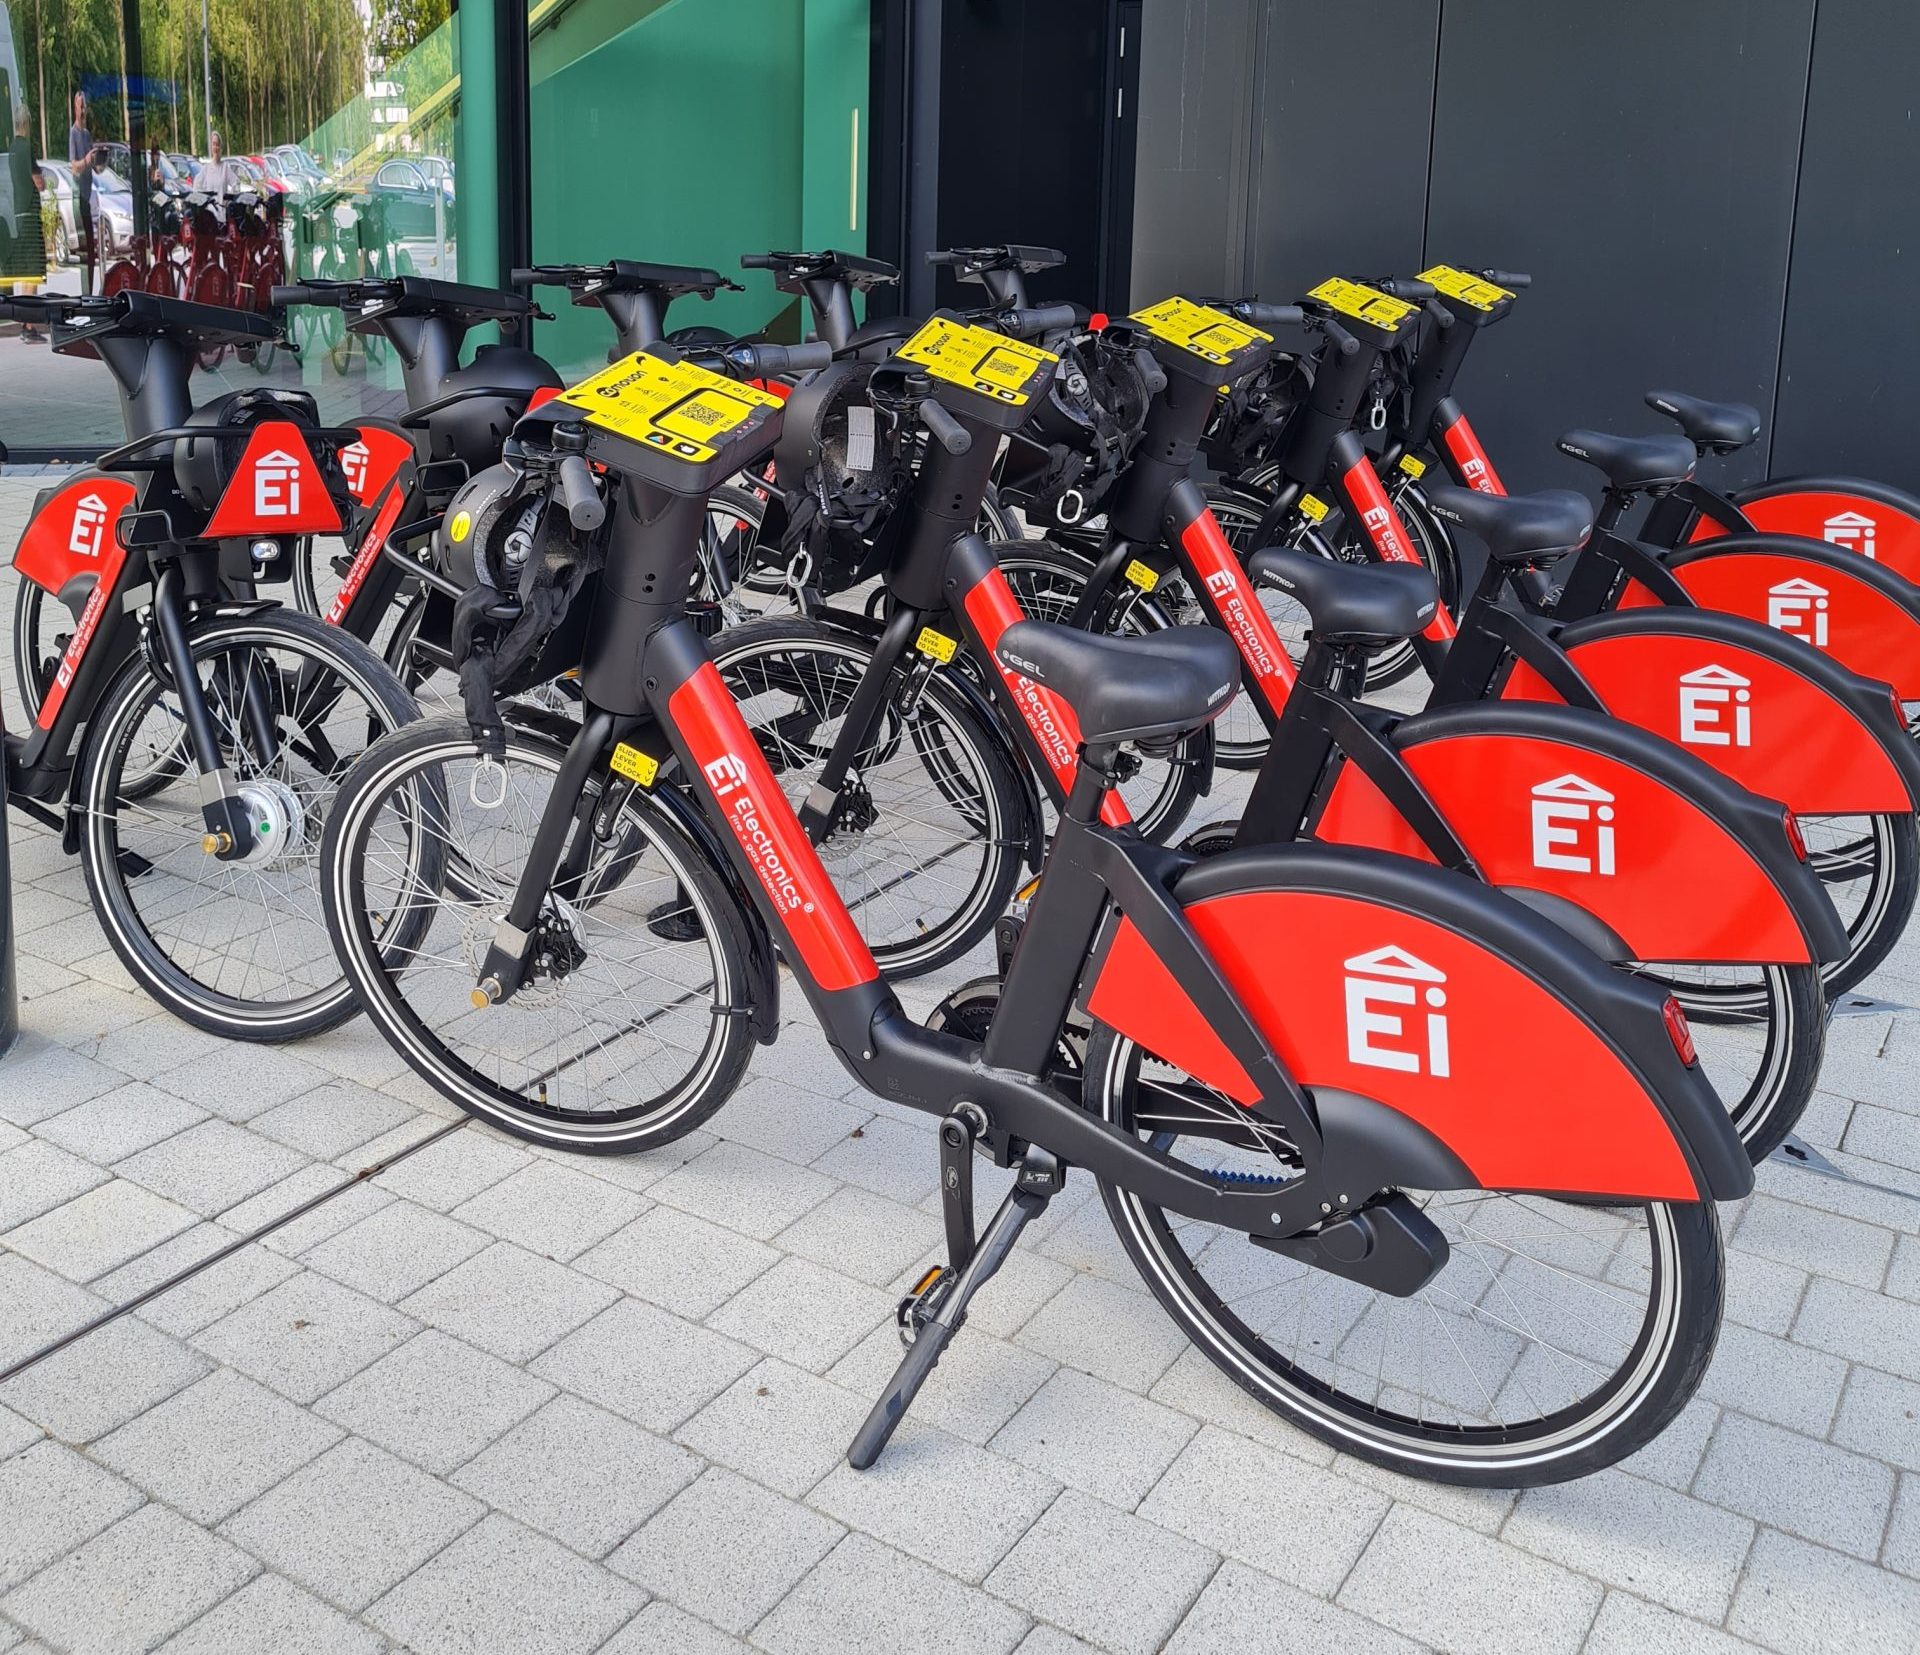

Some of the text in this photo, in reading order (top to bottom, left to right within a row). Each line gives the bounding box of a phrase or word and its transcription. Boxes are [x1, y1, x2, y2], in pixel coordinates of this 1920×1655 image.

[255, 469, 300, 516] Ei
[1462, 459, 1482, 479] Ei
[69, 509, 105, 557] Ei
[1363, 507, 1387, 531] Ei
[1437, 507, 1463, 522] GEL
[341, 532, 377, 594] Electronics
[1262, 568, 1295, 589] WITTKOP
[67, 585, 101, 657] Electronics
[920, 636, 939, 647] LEVER
[924, 629, 940, 640] SLIDE
[1205, 570, 1273, 673] Ei Electronics
[1769, 597, 1828, 646] Ei
[927, 647, 942, 656] LOCK
[1010, 654, 1045, 678] GEL
[1233, 630, 1244, 643] gas
[1242, 644, 1263, 677] detection
[1014, 689, 1024, 703] fire
[1026, 712, 1037, 728] gas
[1037, 730, 1061, 770] detection
[1018, 676, 1072, 765] Electronics
[1680, 686, 1751, 747] Ei
[613, 760, 641, 777] TO LOCK
[615, 753, 637, 767] LEVER
[618, 745, 637, 759] SLIDE
[704, 755, 802, 909] Ei Electronics
[1531, 799, 1615, 876] Ei
[729, 814, 743, 832] fire
[746, 844, 760, 864] gas
[758, 865, 788, 914] detection
[1344, 976, 1450, 1078] Ei
